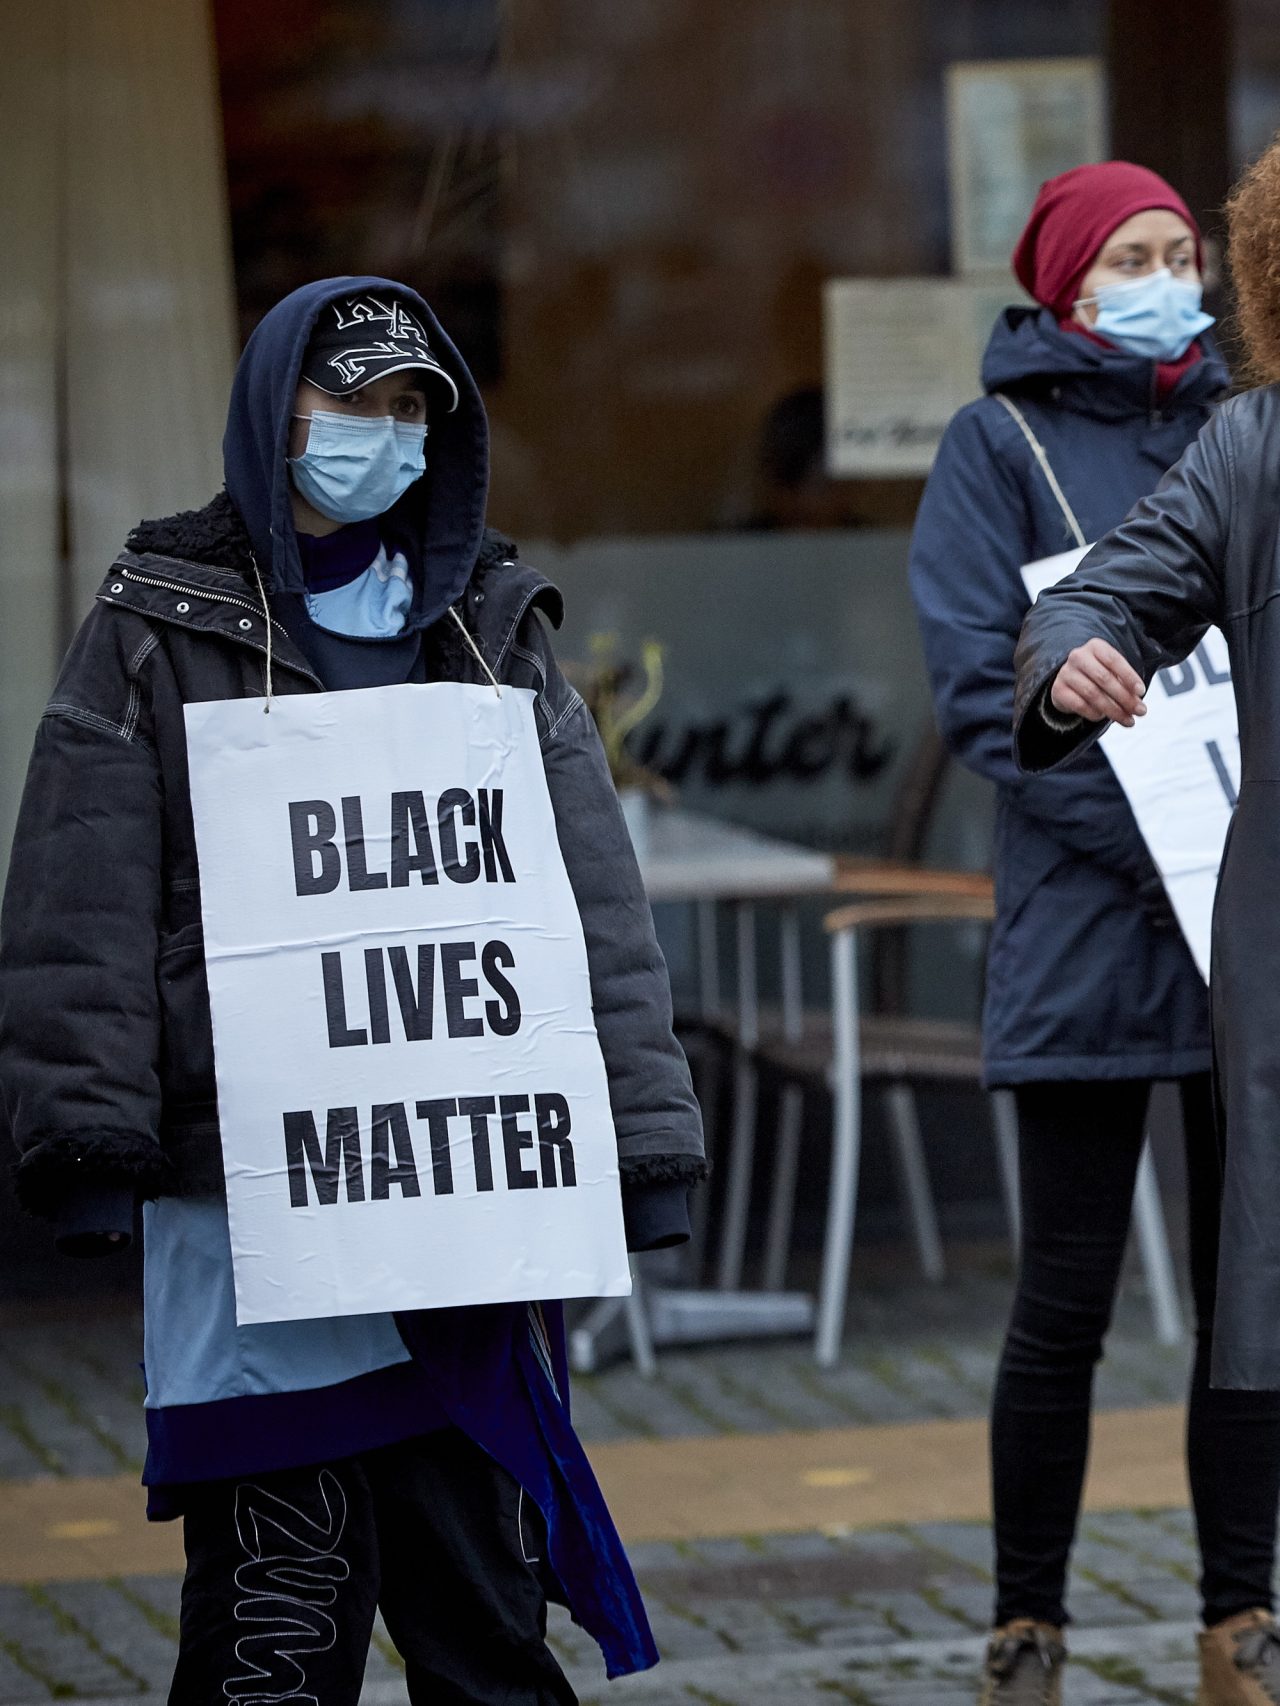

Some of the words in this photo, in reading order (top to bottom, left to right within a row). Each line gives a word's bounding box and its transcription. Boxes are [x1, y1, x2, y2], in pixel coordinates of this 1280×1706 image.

[288, 787, 517, 897] BLACK
[320, 939, 523, 1049] LIVES
[282, 1092, 578, 1209] MATTER
